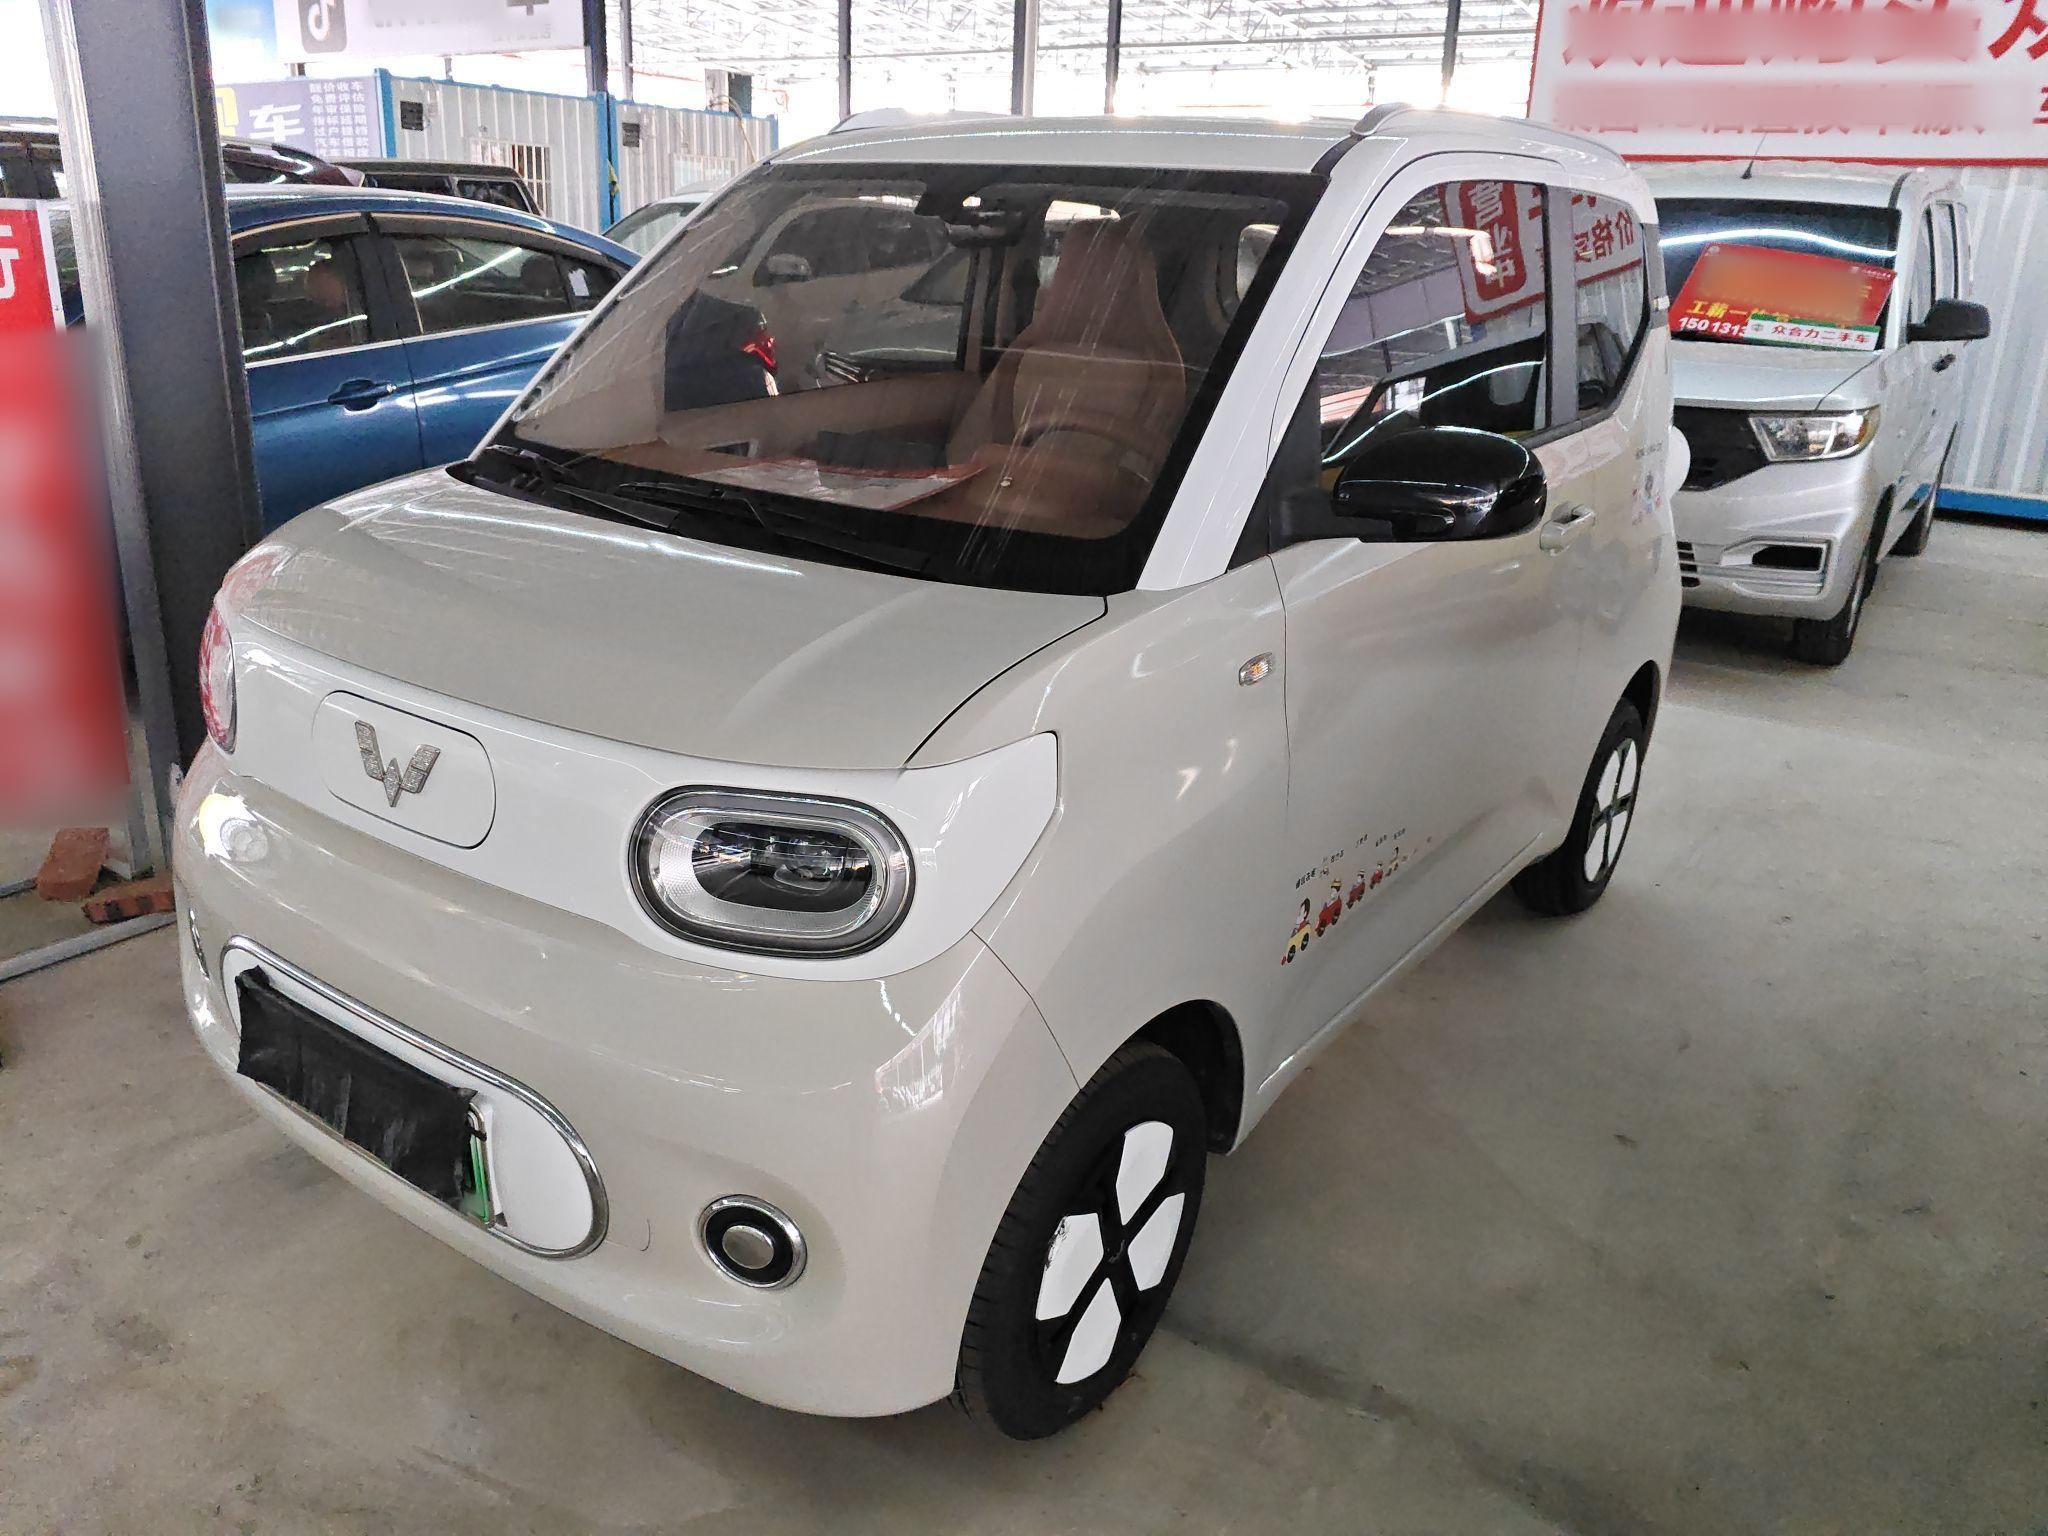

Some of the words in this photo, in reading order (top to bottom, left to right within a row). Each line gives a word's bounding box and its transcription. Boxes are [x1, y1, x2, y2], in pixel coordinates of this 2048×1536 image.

[249, 104, 305, 142] 车
[1771, 324, 1870, 344] 众合力二手车
